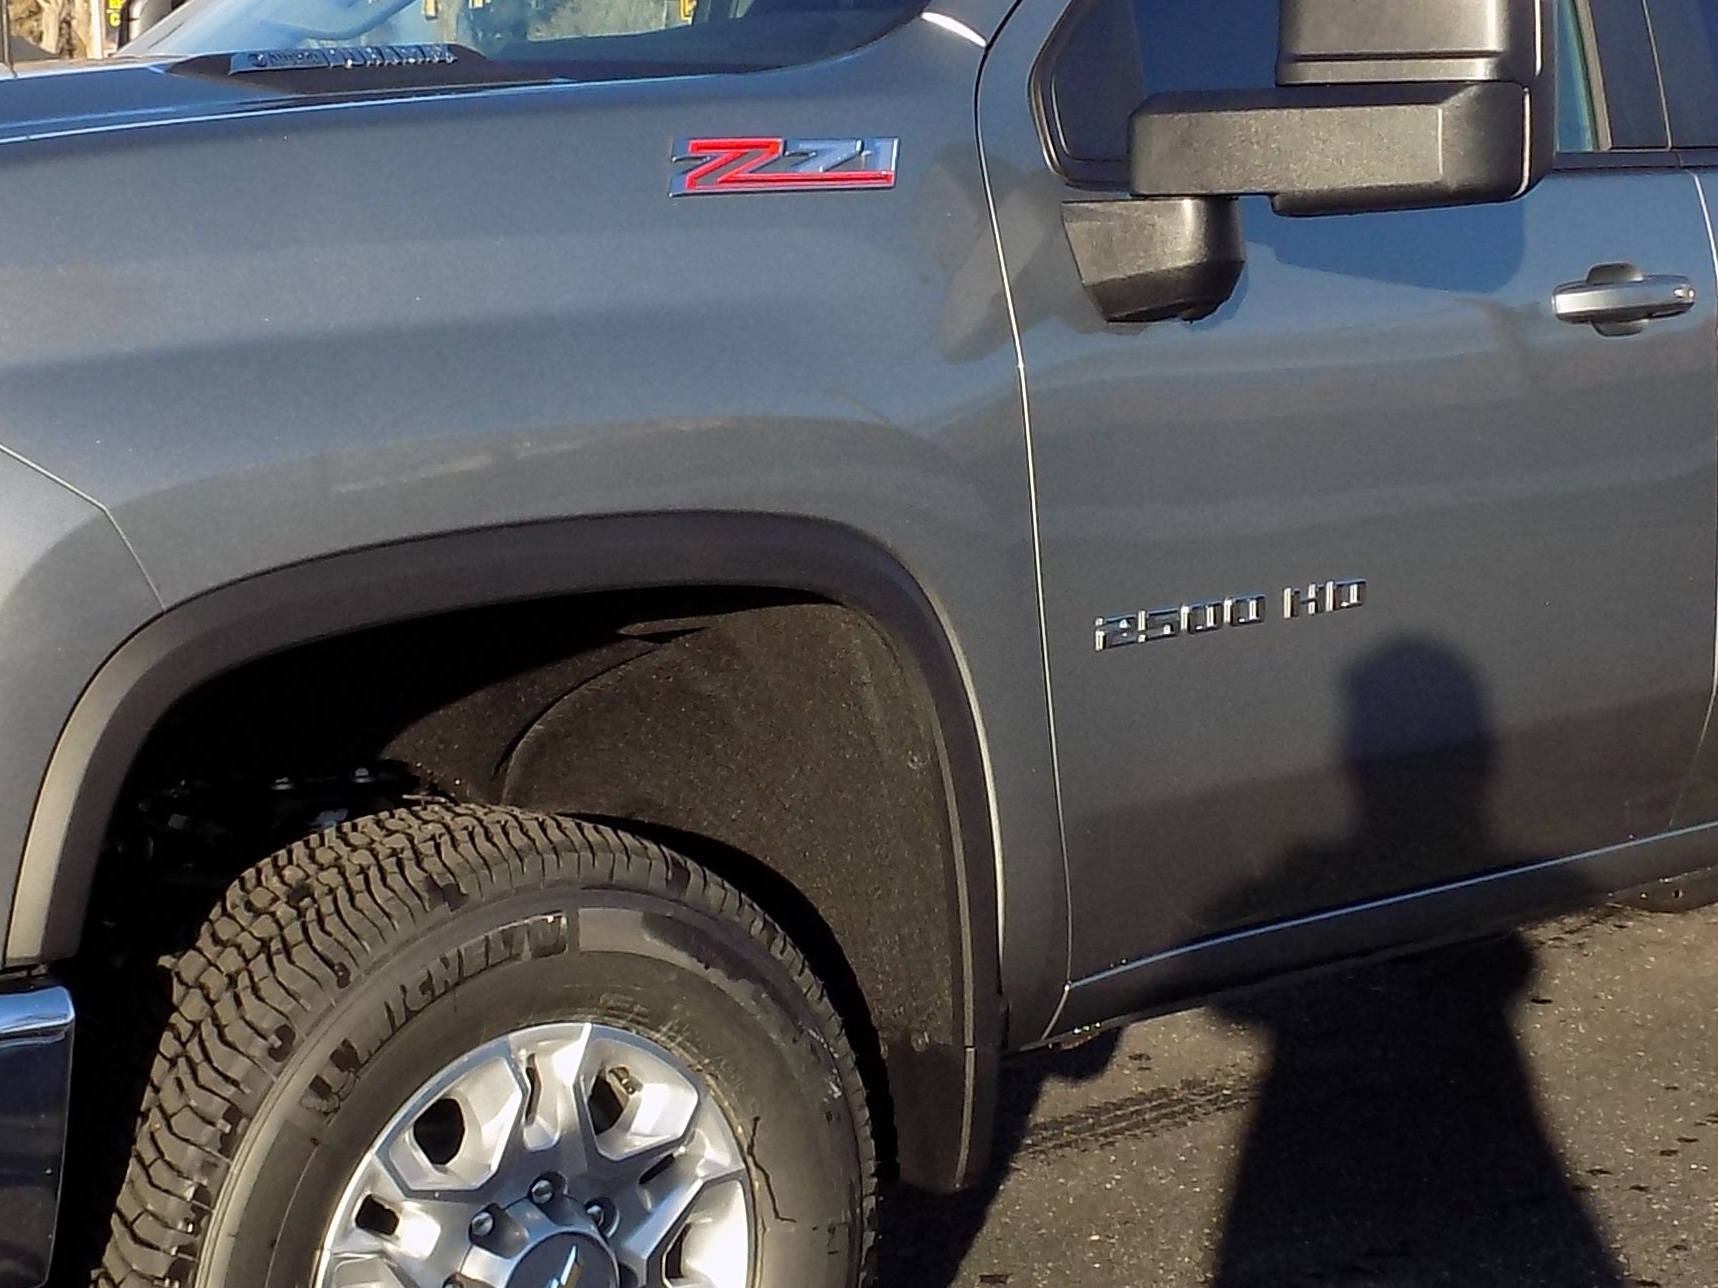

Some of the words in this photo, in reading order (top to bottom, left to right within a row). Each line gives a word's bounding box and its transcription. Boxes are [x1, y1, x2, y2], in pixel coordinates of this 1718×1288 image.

[669, 137, 900, 197] Z71
[1094, 594, 1266, 652] 2500
[1283, 578, 1367, 620] HD
